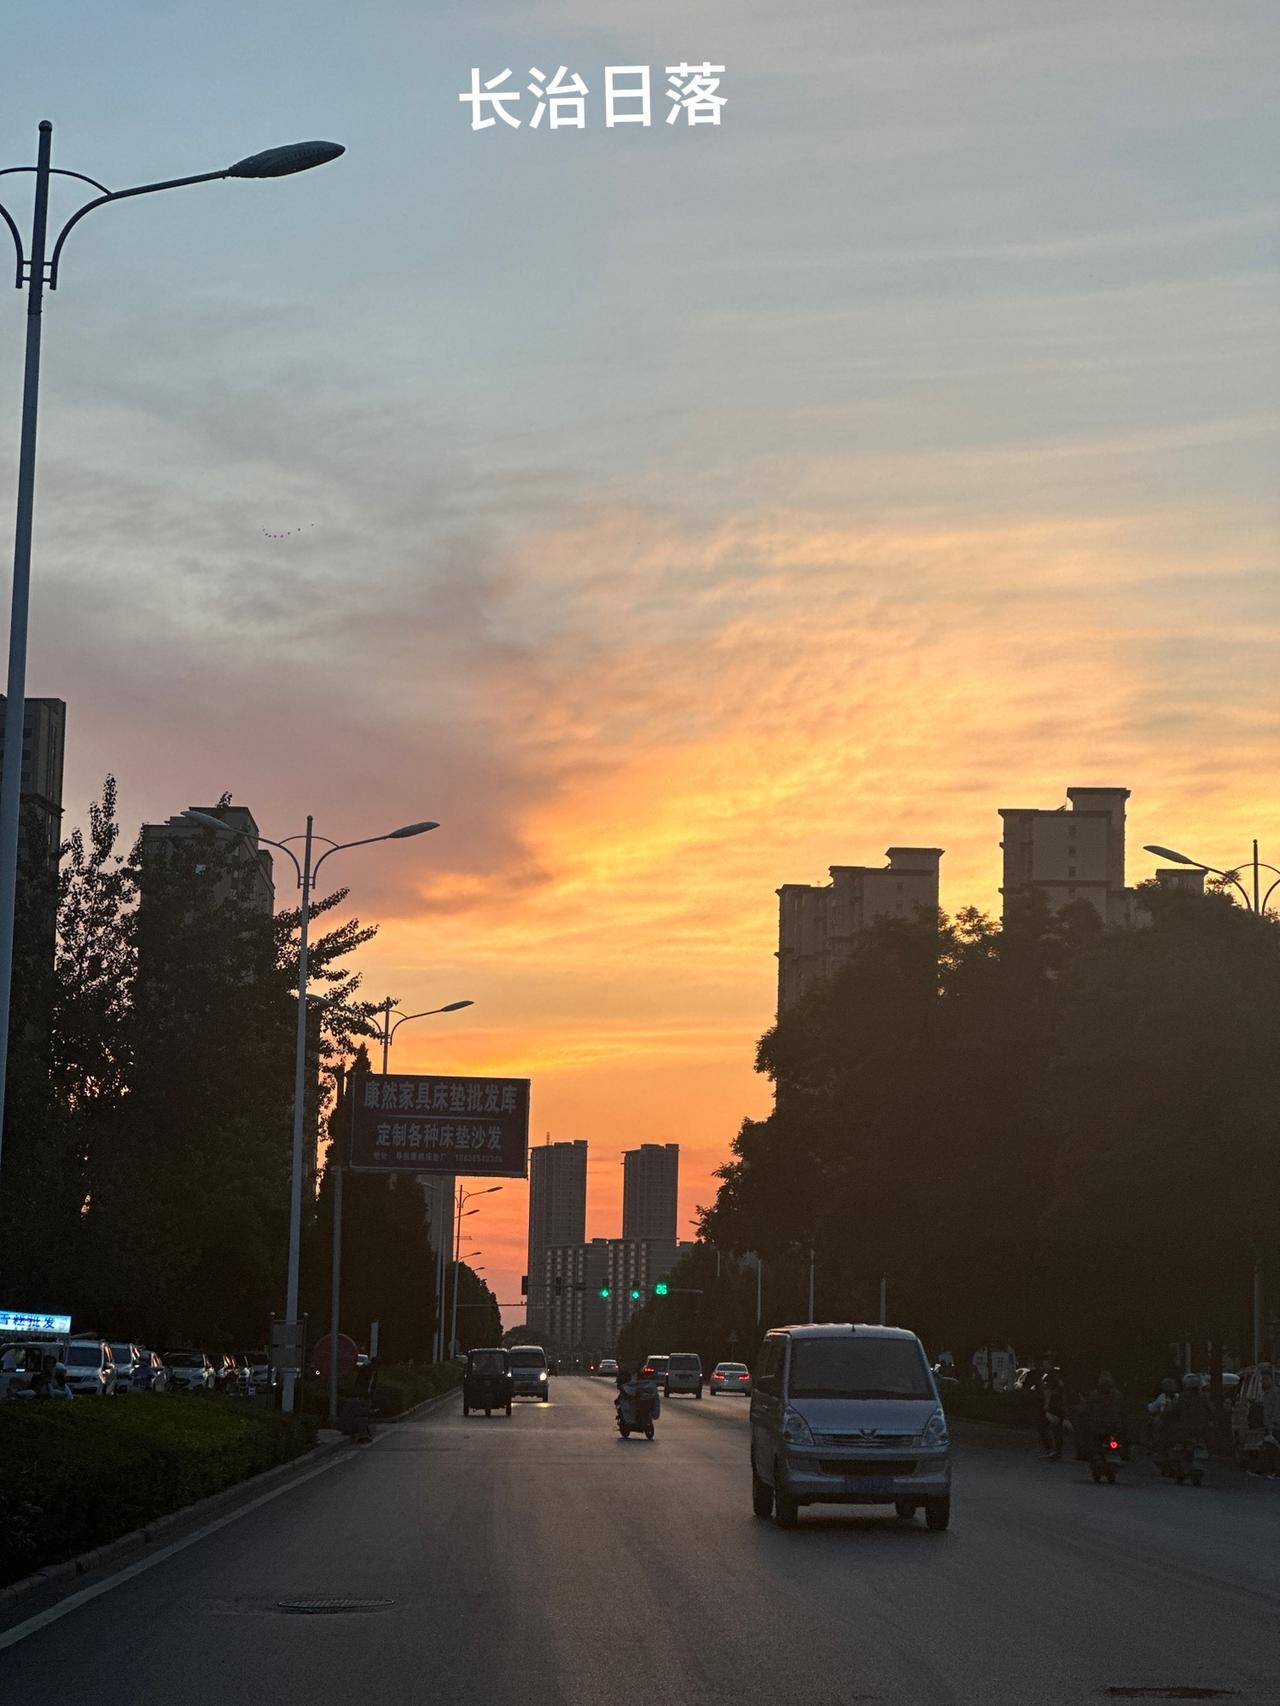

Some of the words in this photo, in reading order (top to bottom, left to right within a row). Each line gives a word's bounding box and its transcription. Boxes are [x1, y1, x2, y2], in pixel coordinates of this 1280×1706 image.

[364, 1081, 517, 1114] 康然家具床垫批发库
[375, 1122, 501, 1150] 定制各种床垫沙发
